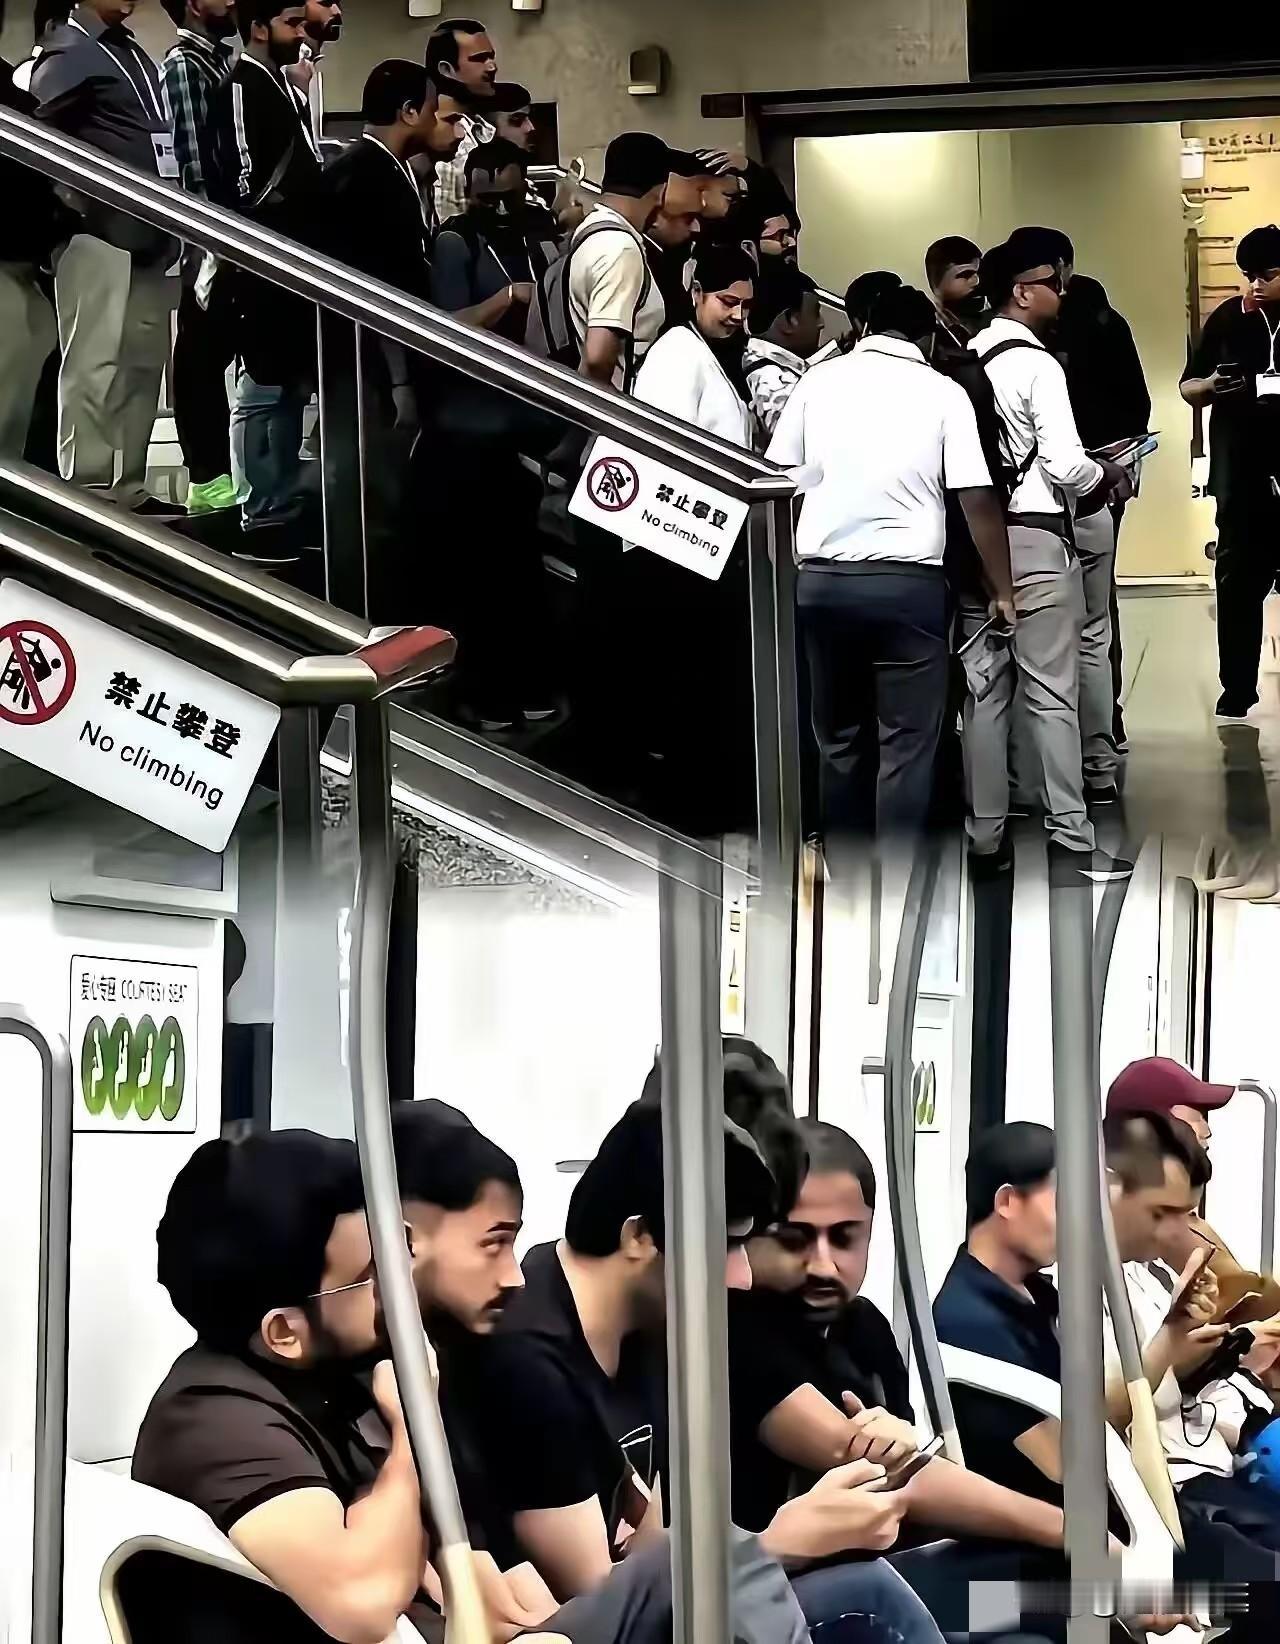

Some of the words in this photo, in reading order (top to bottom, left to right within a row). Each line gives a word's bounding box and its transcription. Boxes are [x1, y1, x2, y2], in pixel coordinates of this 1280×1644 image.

[641, 509, 660, 526] No
[663, 523, 720, 557] climbing
[105, 671, 241, 759] 禁止攀登
[79, 720, 115, 752] No
[120, 746, 224, 810] climbing
